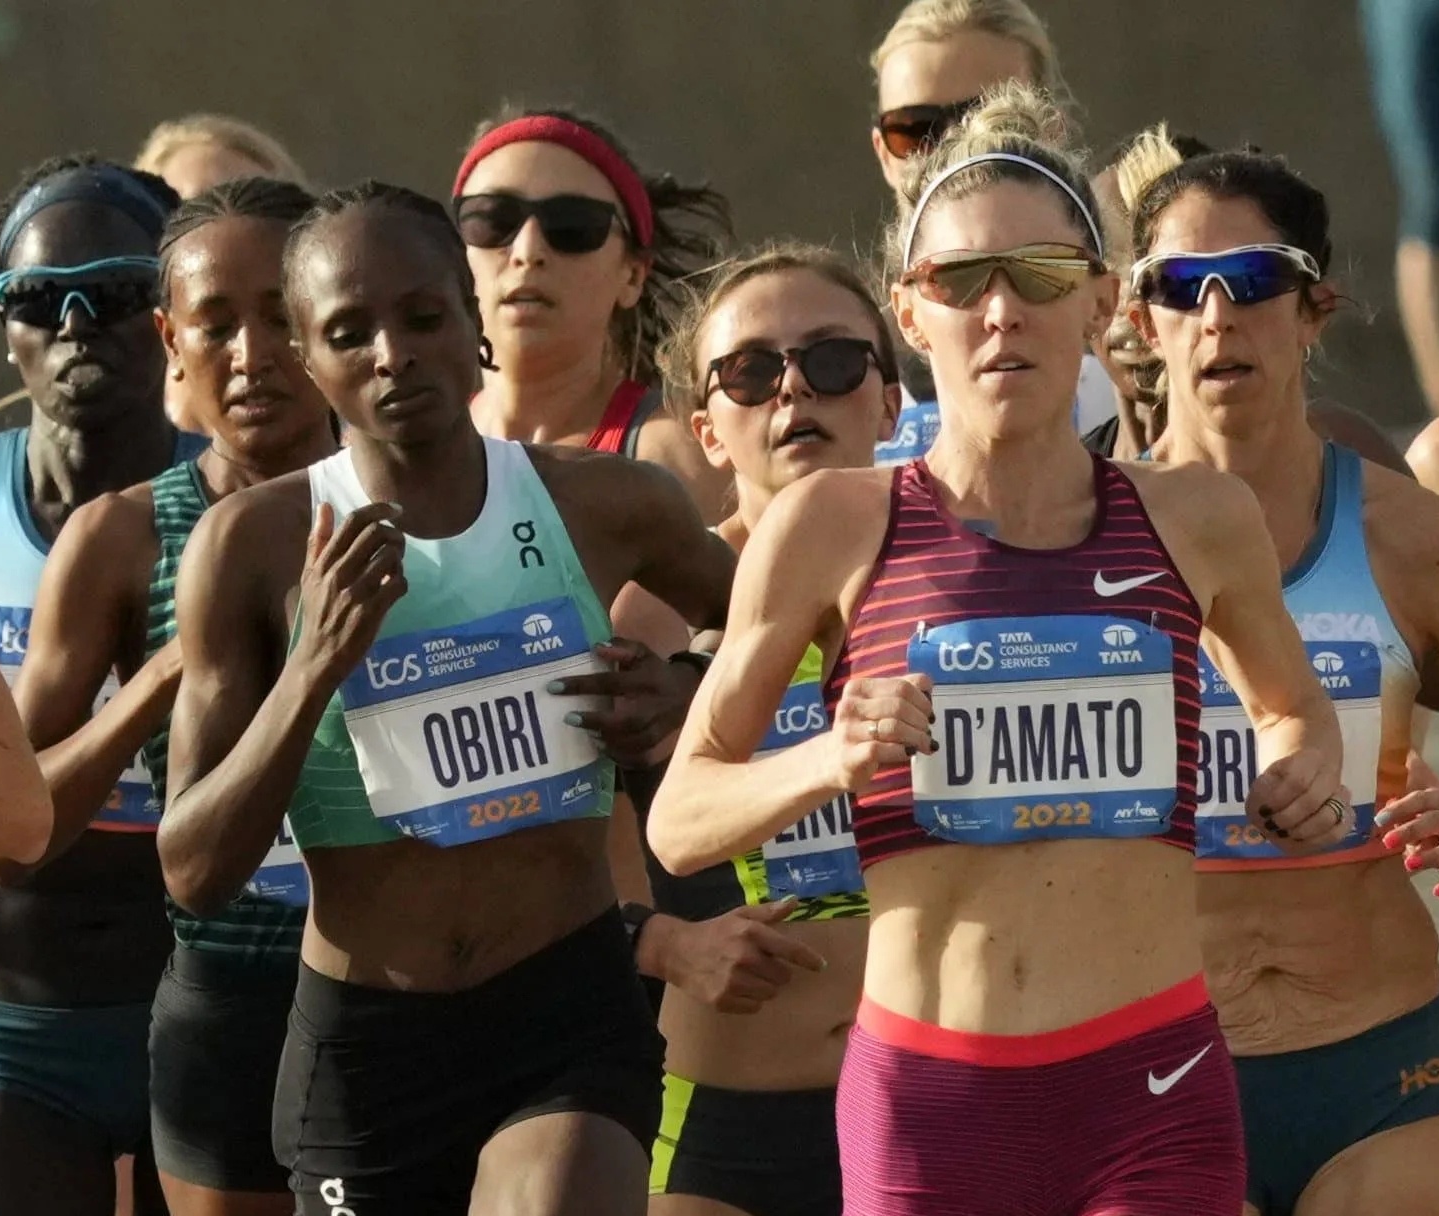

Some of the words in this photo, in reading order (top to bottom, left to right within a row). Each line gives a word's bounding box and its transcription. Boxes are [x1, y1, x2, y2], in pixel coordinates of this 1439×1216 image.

[422, 638, 456, 651] TATA
[521, 636, 564, 656] TATA
[998, 632, 1033, 643] TATA
[425, 640, 500, 665] CONSULTANCY
[938, 641, 994, 672] tcs
[999, 642, 1078, 656] CONSULTANCY
[1098, 650, 1143, 665] TATA
[365, 653, 422, 690] tcs
[428, 658, 476, 677] SERVICES
[1000, 656, 1051, 669] SERVICES
[1320, 675, 1351, 689] ATA
[422, 691, 549, 789] OBIRI
[466, 791, 542, 829] 2022
[1012, 801, 1093, 829] 2022
